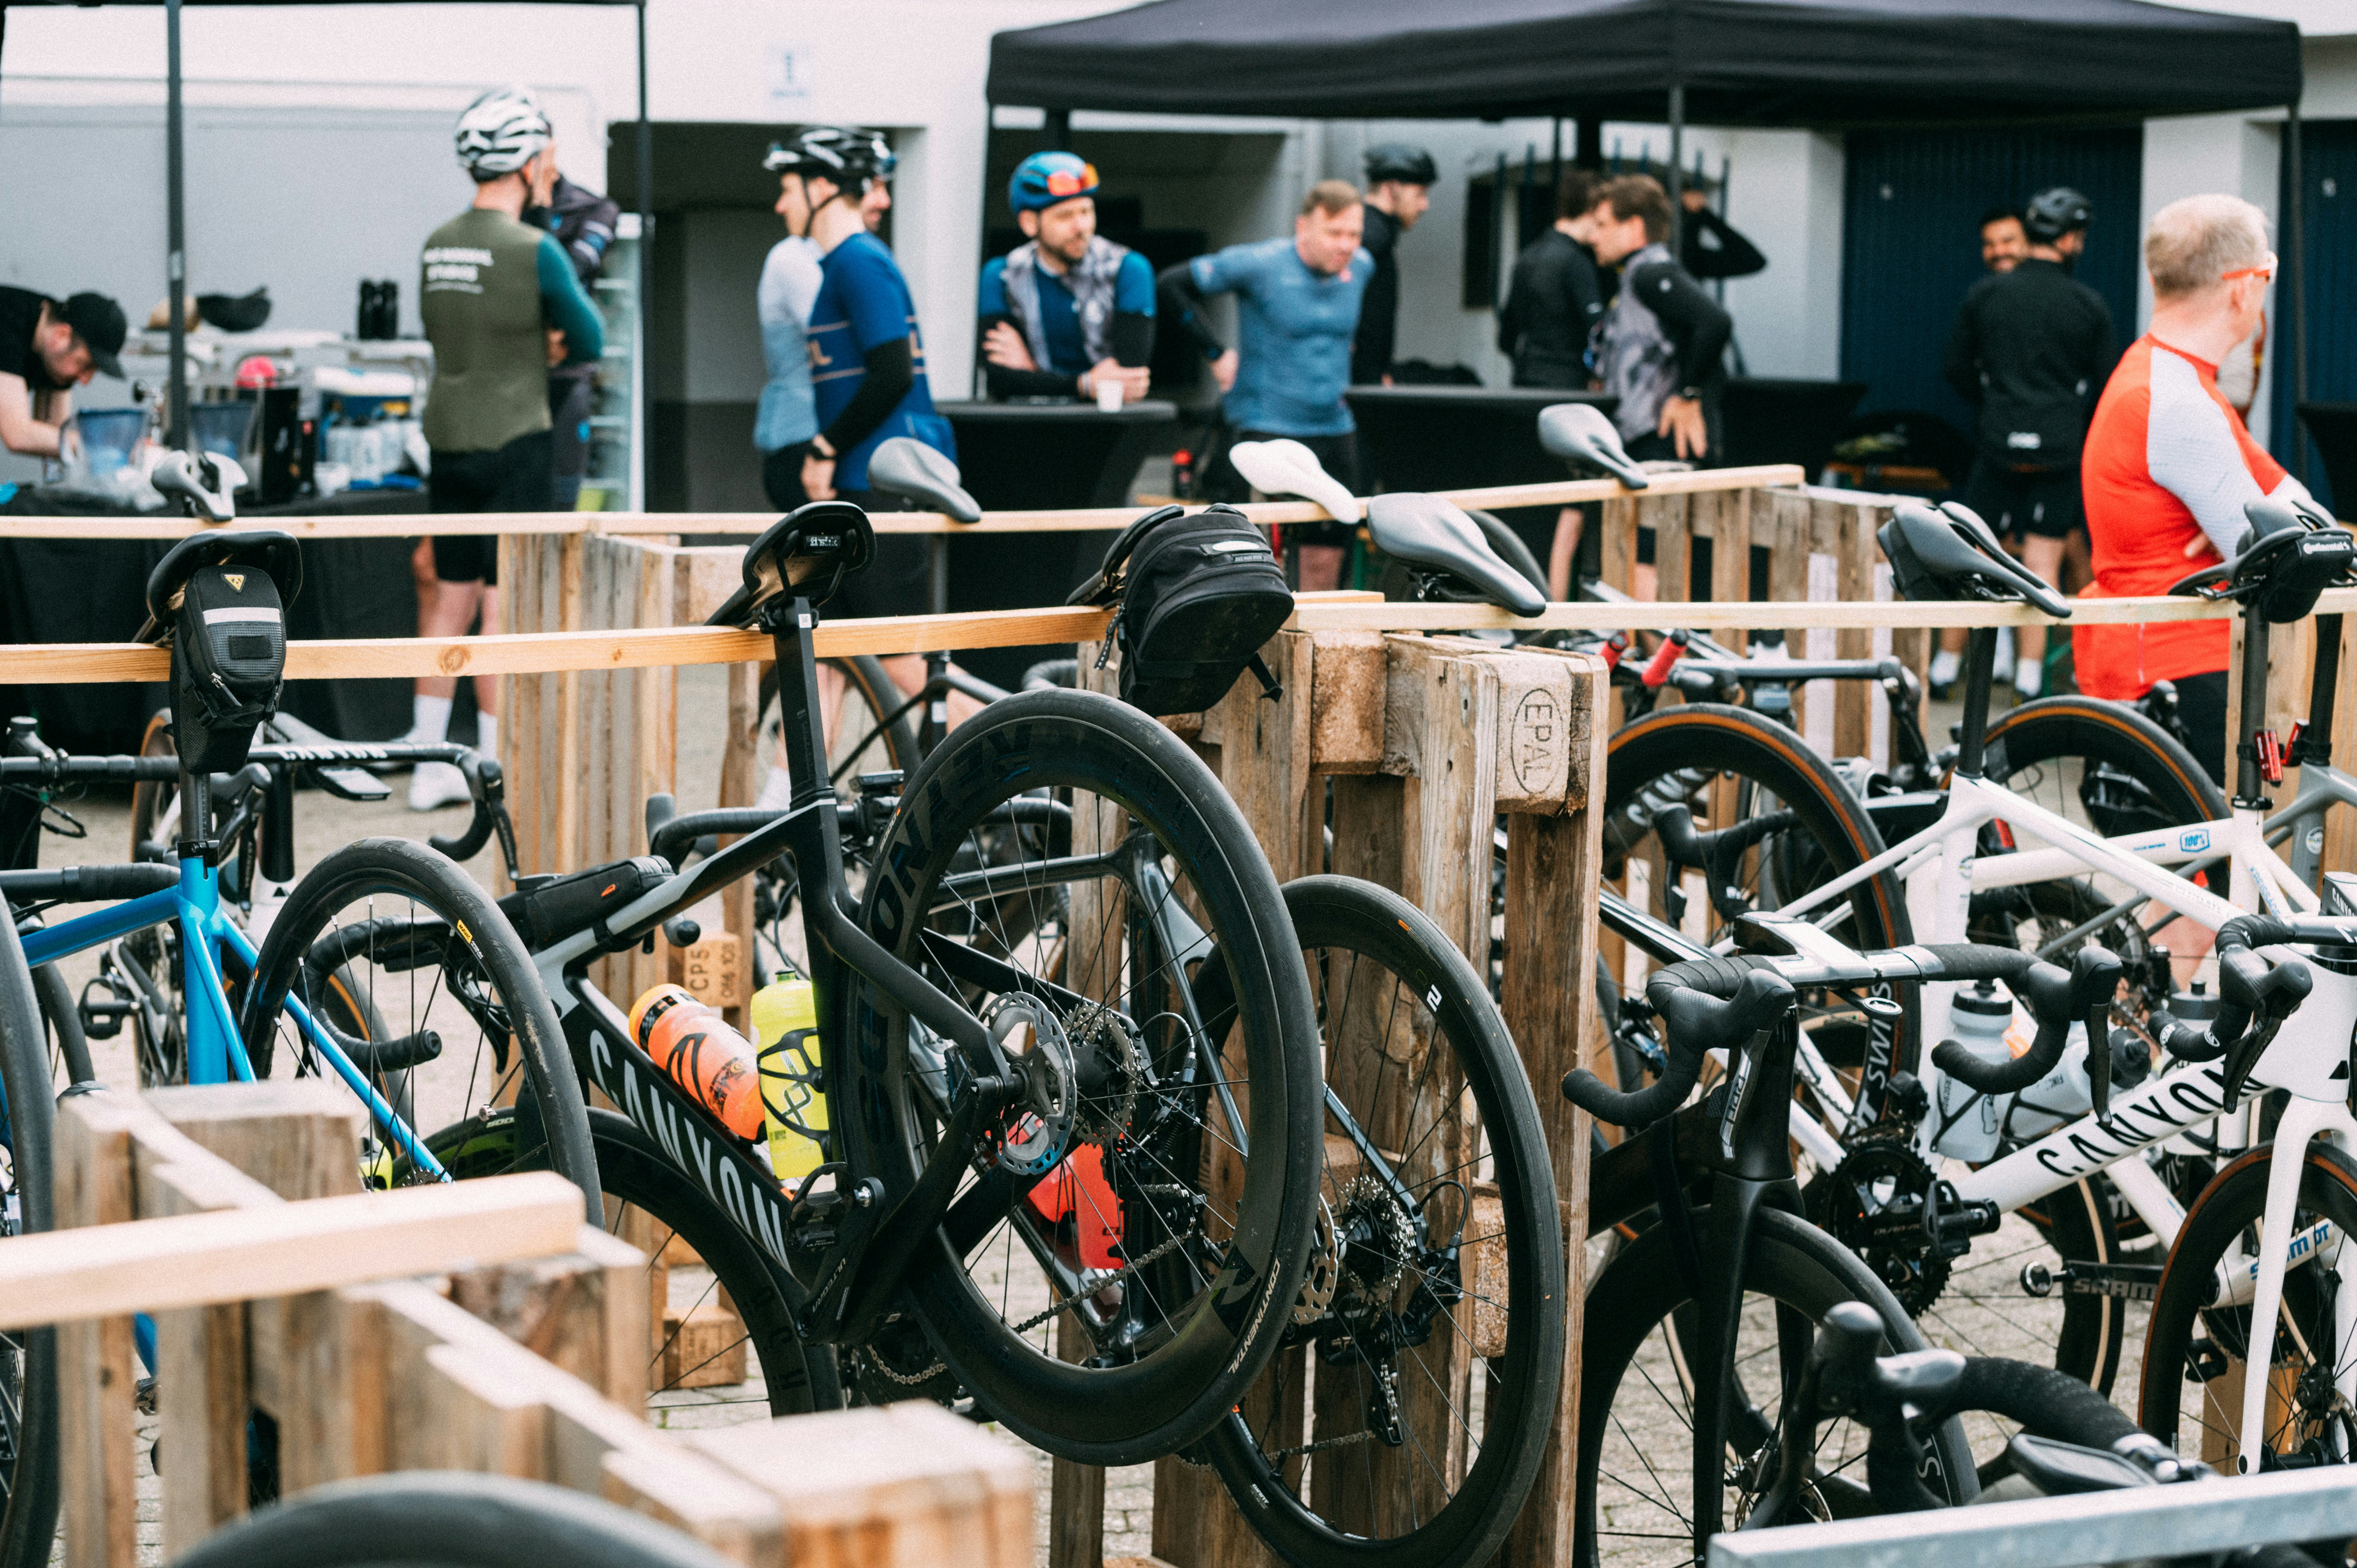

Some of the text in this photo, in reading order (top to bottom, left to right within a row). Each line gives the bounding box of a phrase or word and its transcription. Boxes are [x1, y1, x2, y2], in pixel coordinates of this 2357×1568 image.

[1523, 705, 1553, 780] EPAL
[459, 924, 471, 940] MAVIC
[689, 949, 710, 991] CP5
[590, 1030, 795, 1278] CANYON
[812, 1257, 846, 1313] ULTEGRA
[2073, 1277, 2158, 1300] SRAM
[1228, 1257, 1281, 1374] CONTINENTAL
